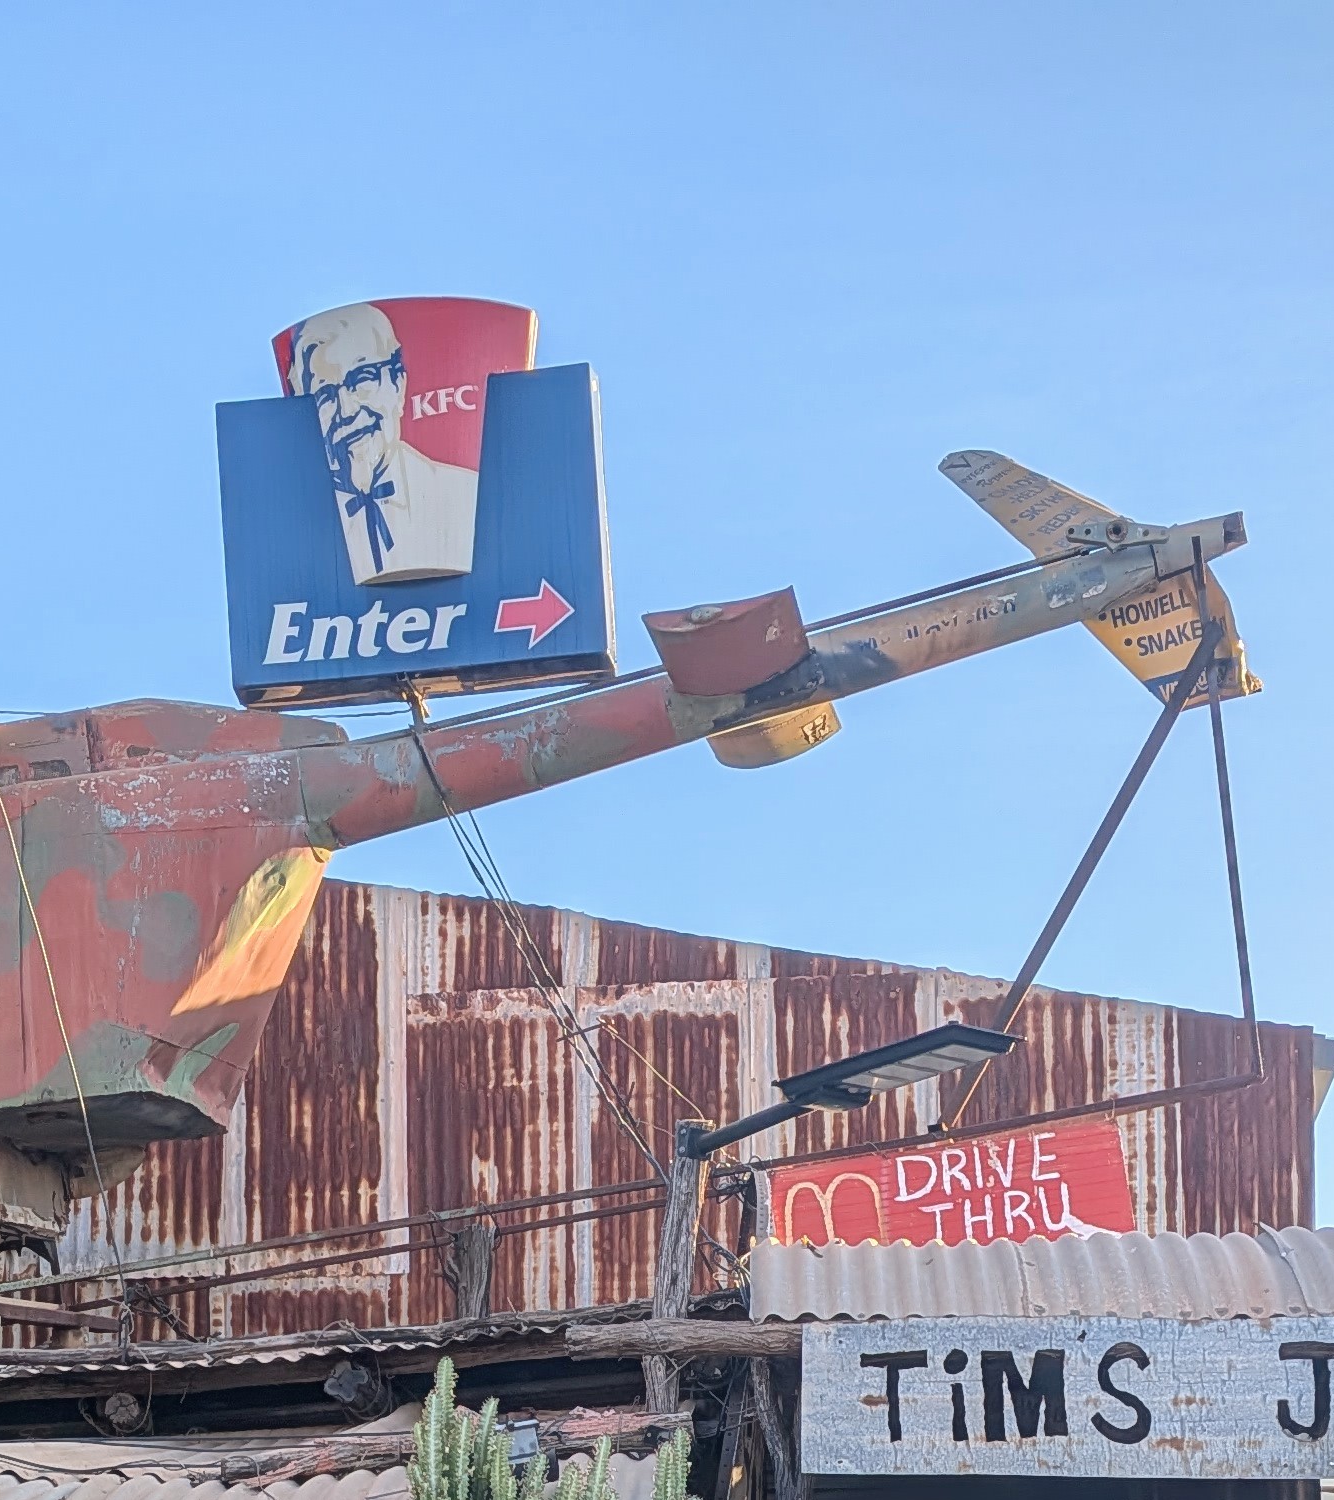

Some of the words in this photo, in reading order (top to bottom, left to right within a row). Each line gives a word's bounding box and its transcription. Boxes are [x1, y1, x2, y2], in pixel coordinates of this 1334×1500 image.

[411, 385, 476, 421] KFC
[262, 601, 467, 666] Enter
[1111, 588, 1192, 628] HOWELL
[894, 1132, 1061, 1203] DRIVE
[918, 1183, 1077, 1243] THRU
